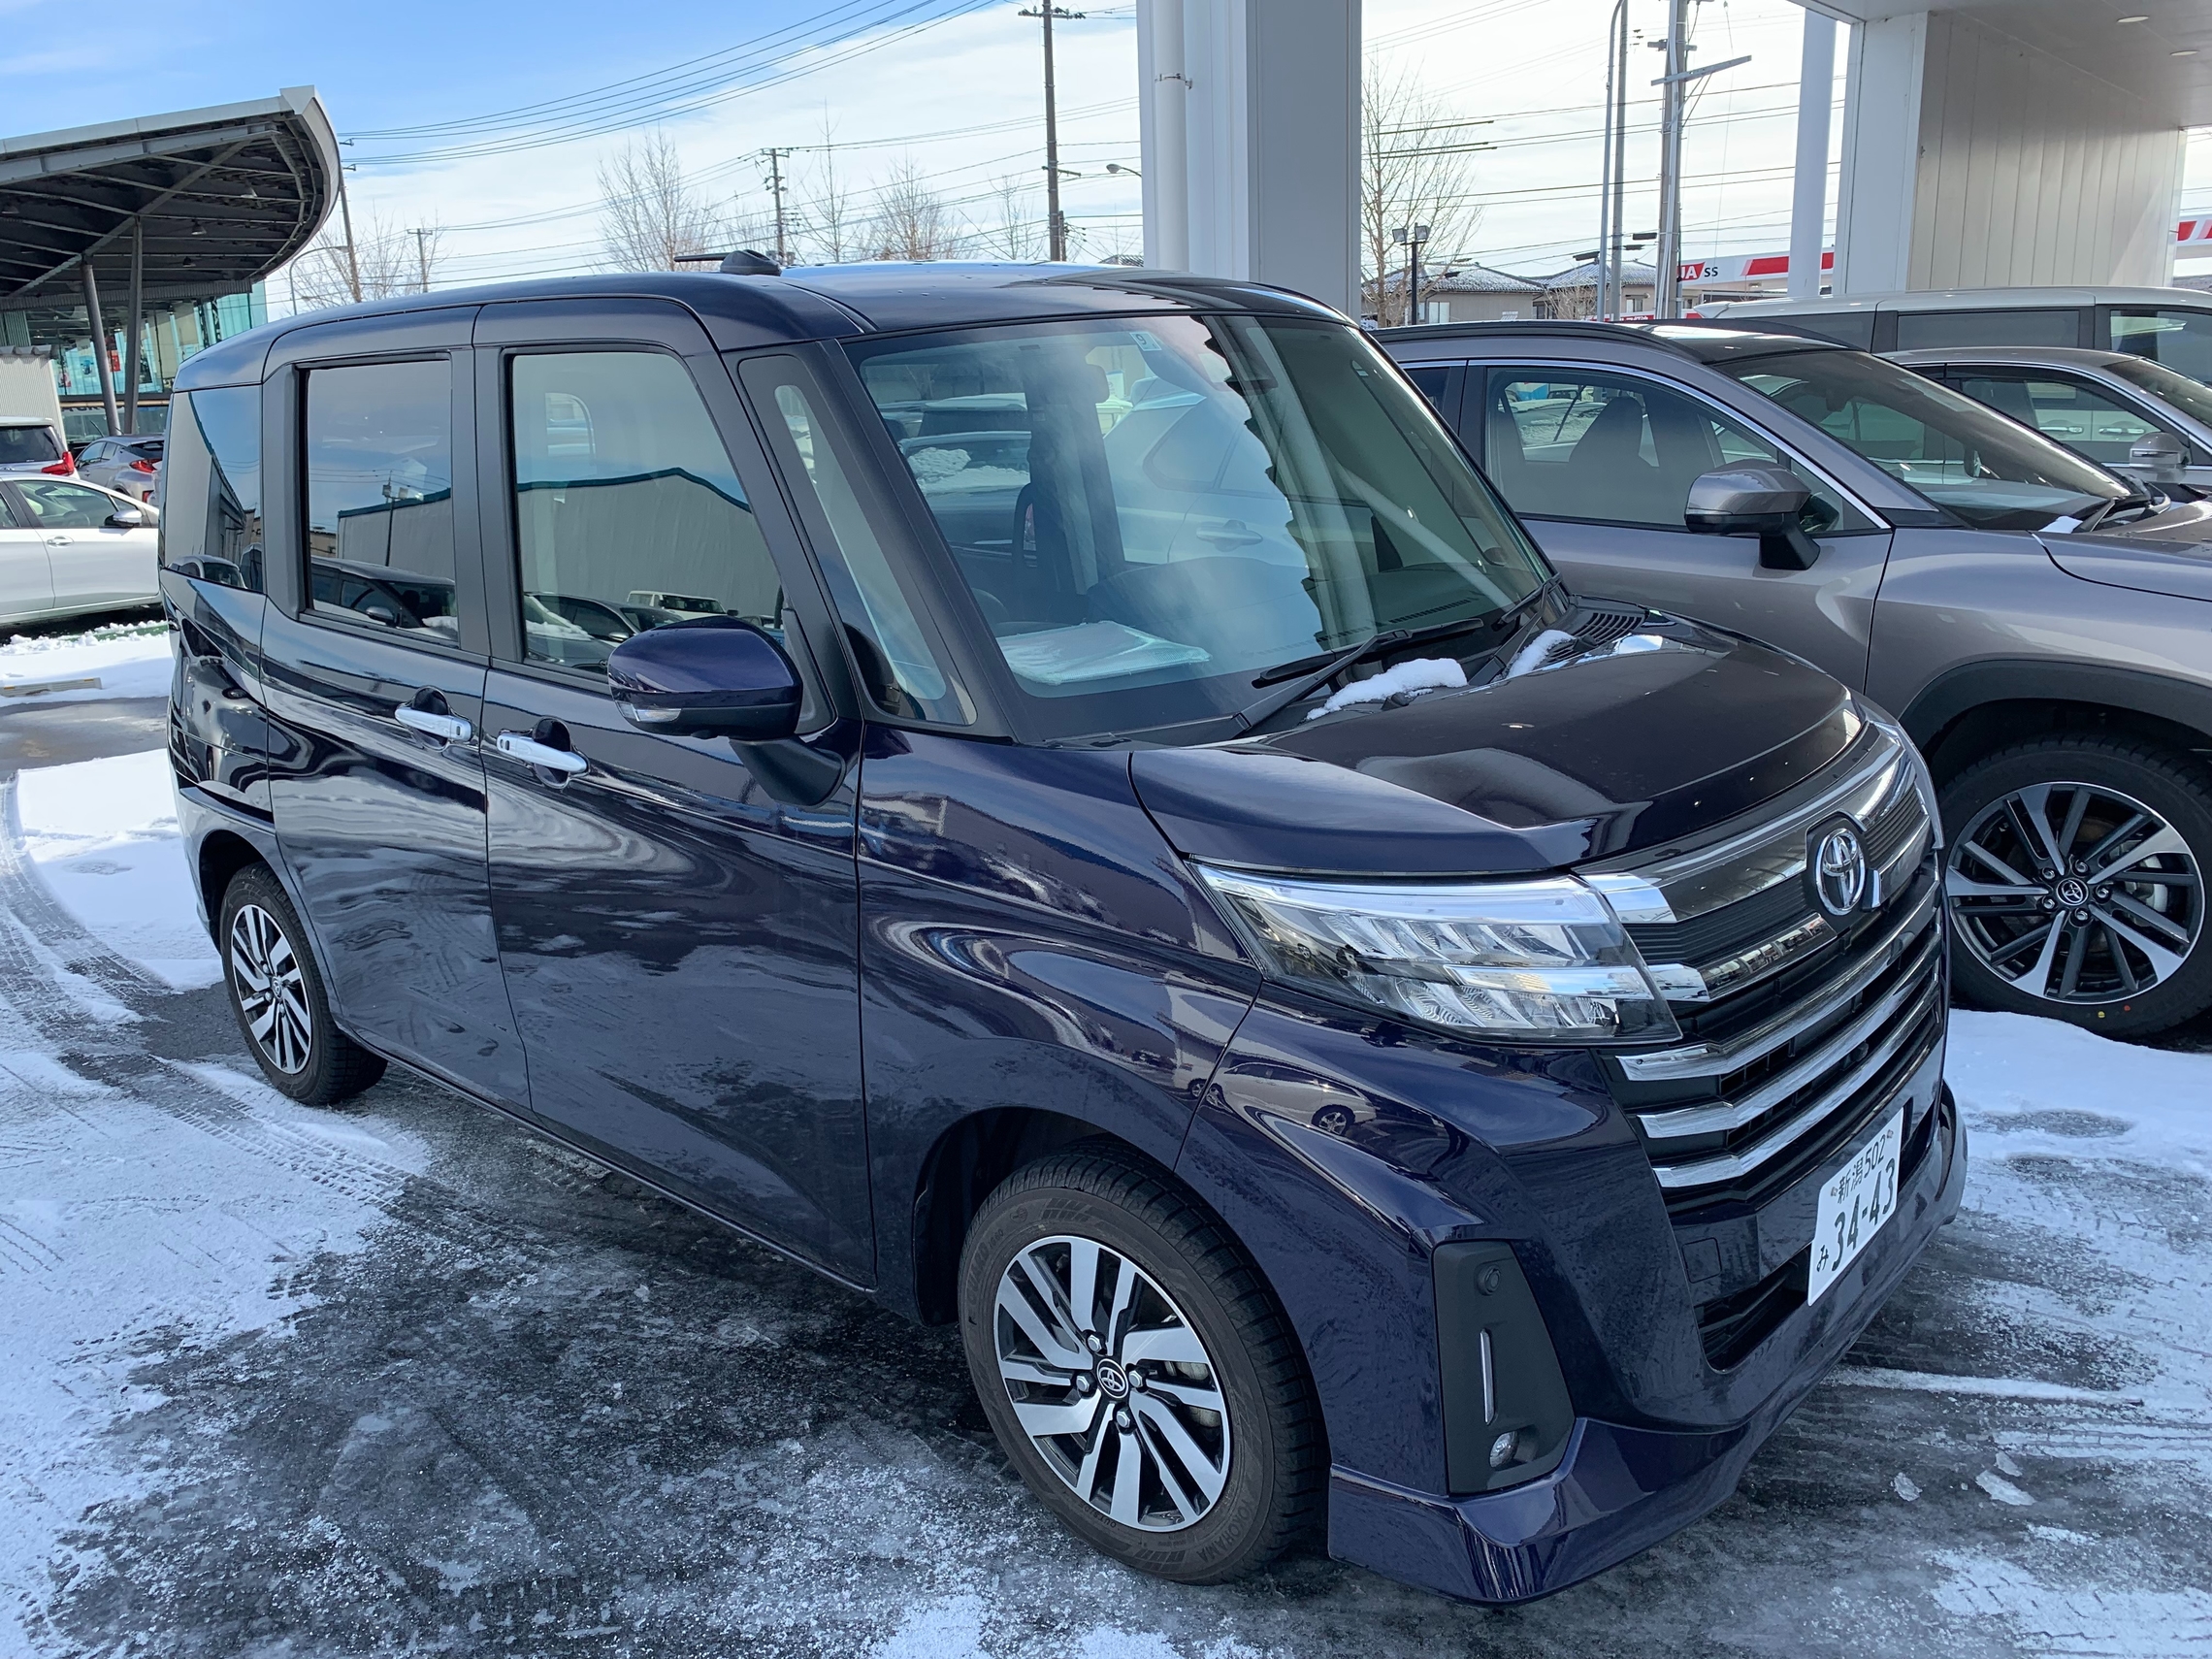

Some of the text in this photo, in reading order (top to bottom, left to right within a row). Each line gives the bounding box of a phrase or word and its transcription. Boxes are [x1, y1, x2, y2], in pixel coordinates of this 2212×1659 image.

[1704, 266, 1719, 277] SS
[1135, 334, 1147, 345] 9
[1077, 1502, 1118, 1529] OUTSIDE
[1196, 1499, 1254, 1563] YOKOHAMA
